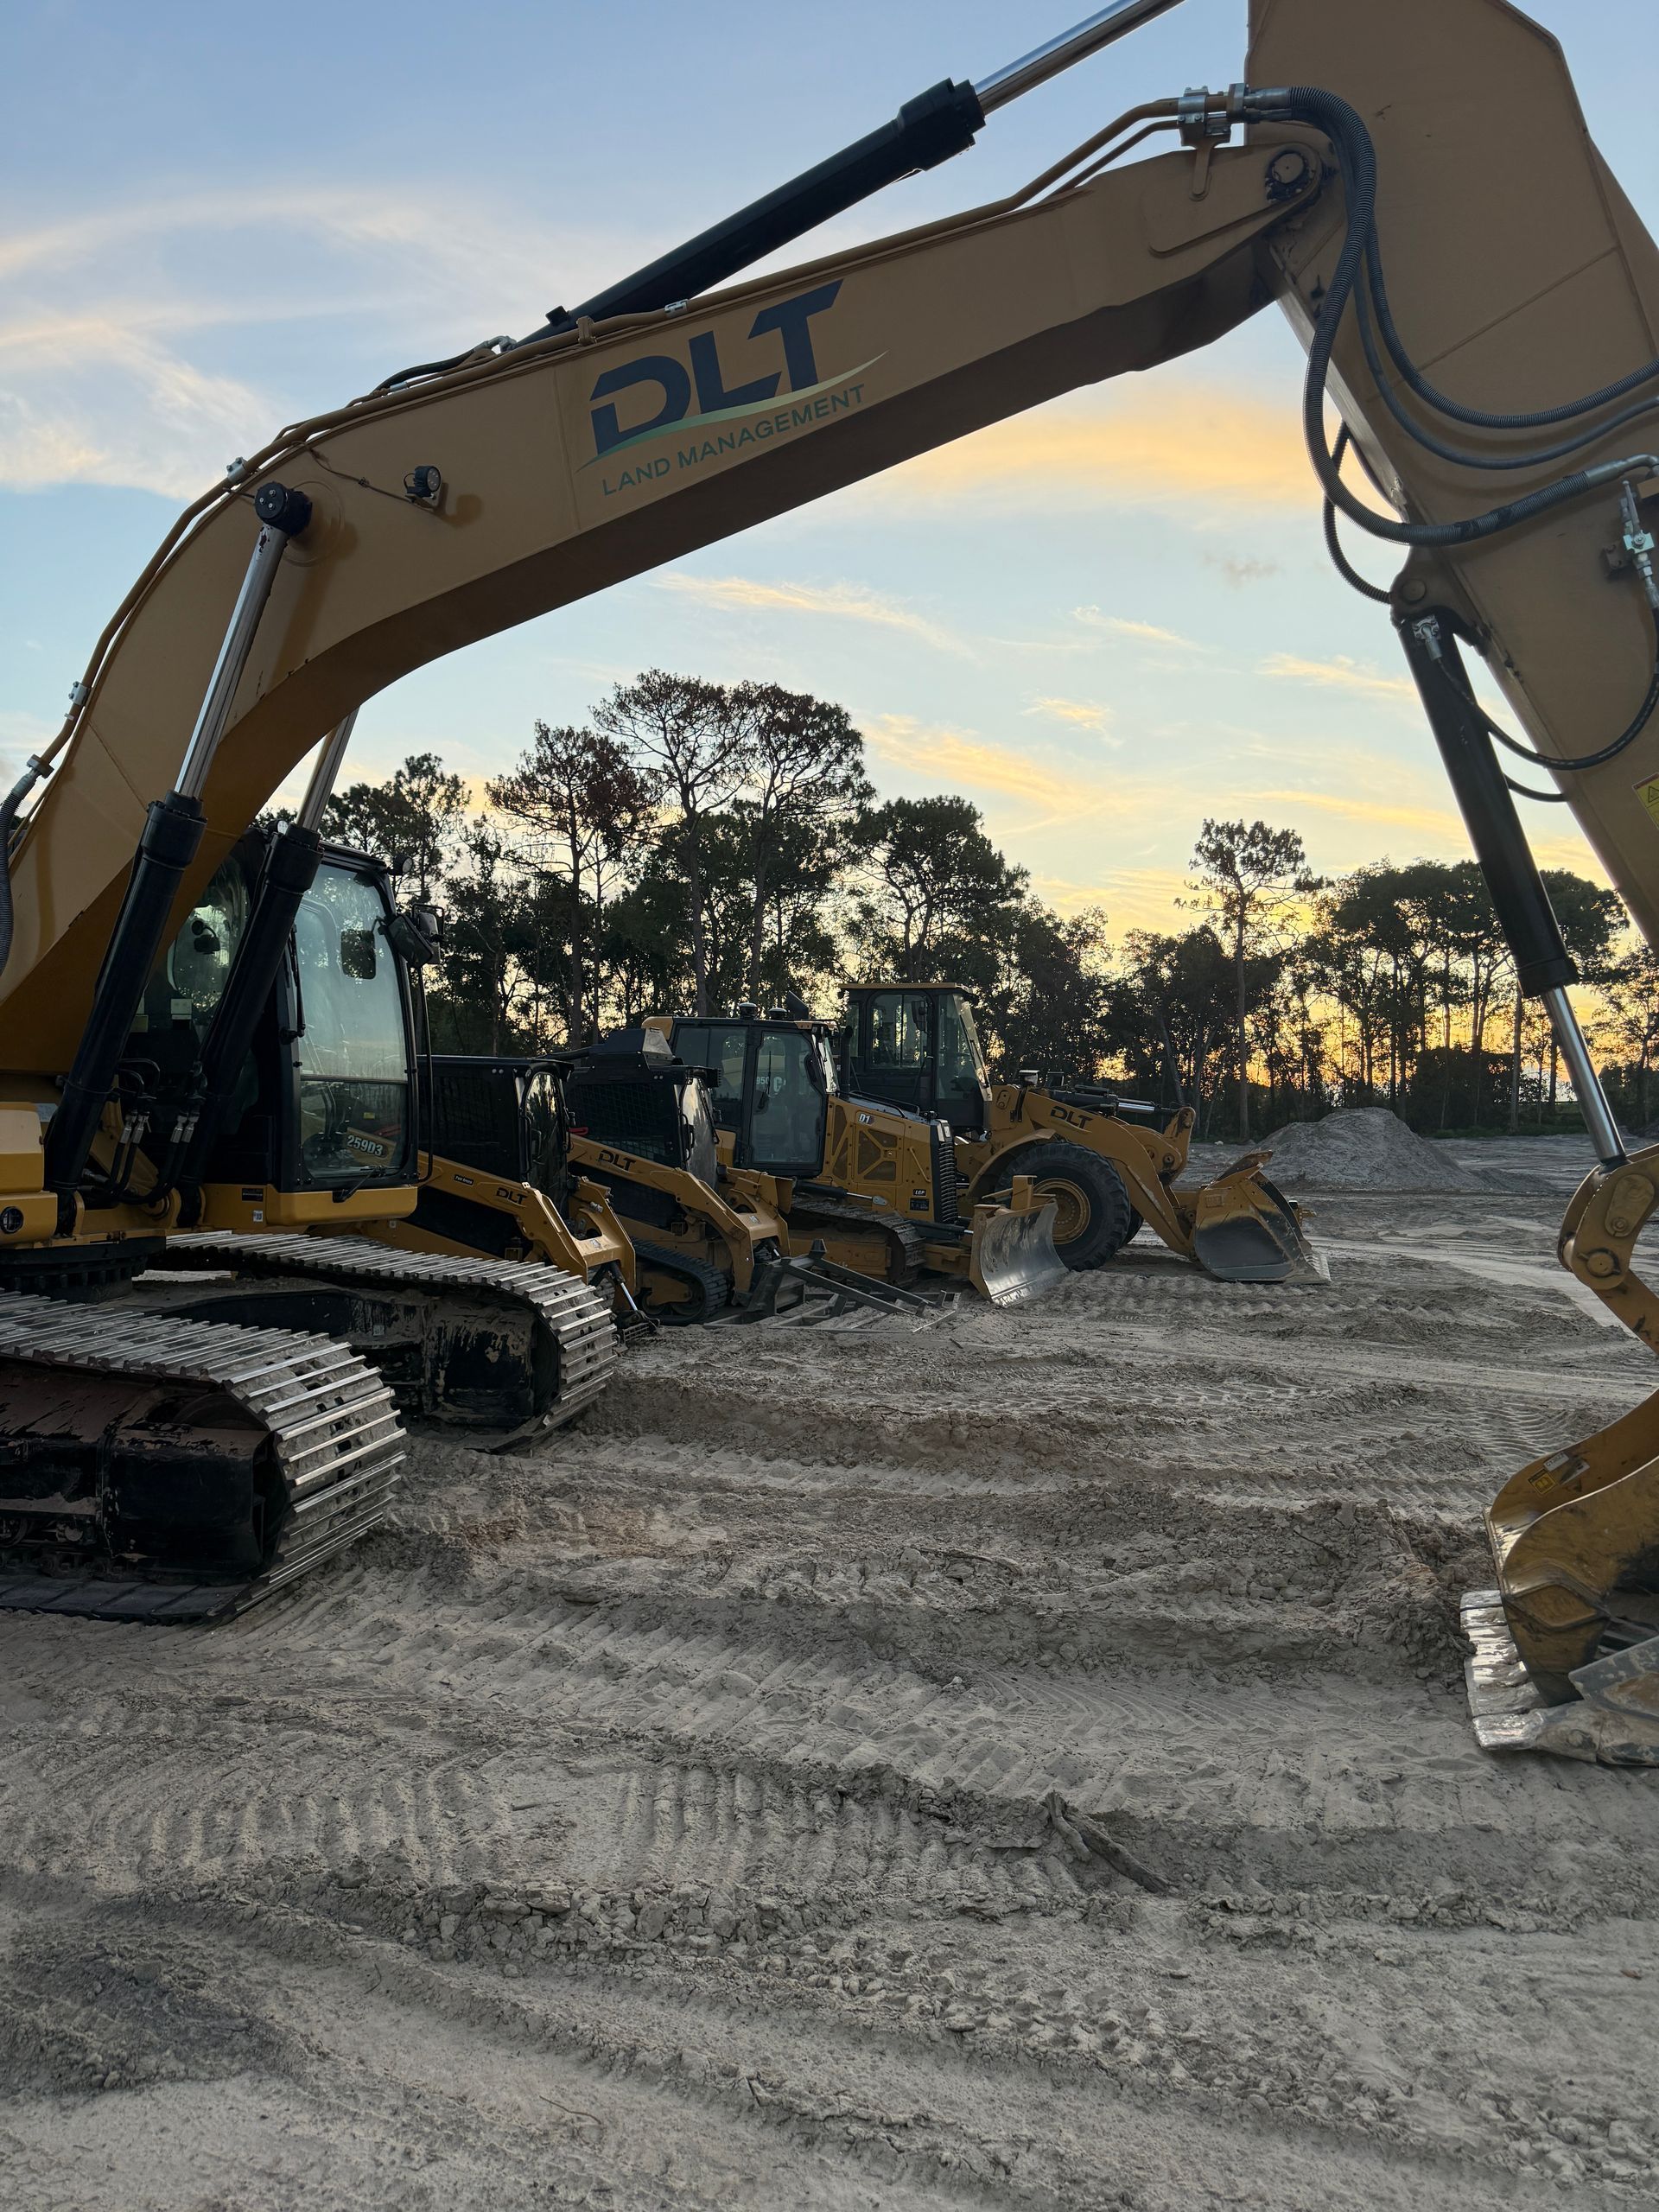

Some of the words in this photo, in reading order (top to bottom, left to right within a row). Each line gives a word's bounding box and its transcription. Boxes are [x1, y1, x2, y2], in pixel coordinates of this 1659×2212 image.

[589, 278, 844, 454] DLT
[602, 458, 671, 496] LAND
[677, 384, 865, 468] MANAGEMENT
[1050, 1106, 1093, 1128] DLT
[347, 1135, 383, 1156] 259D3
[598, 1149, 636, 1171] DLT
[496, 1187, 528, 1205] DLT
